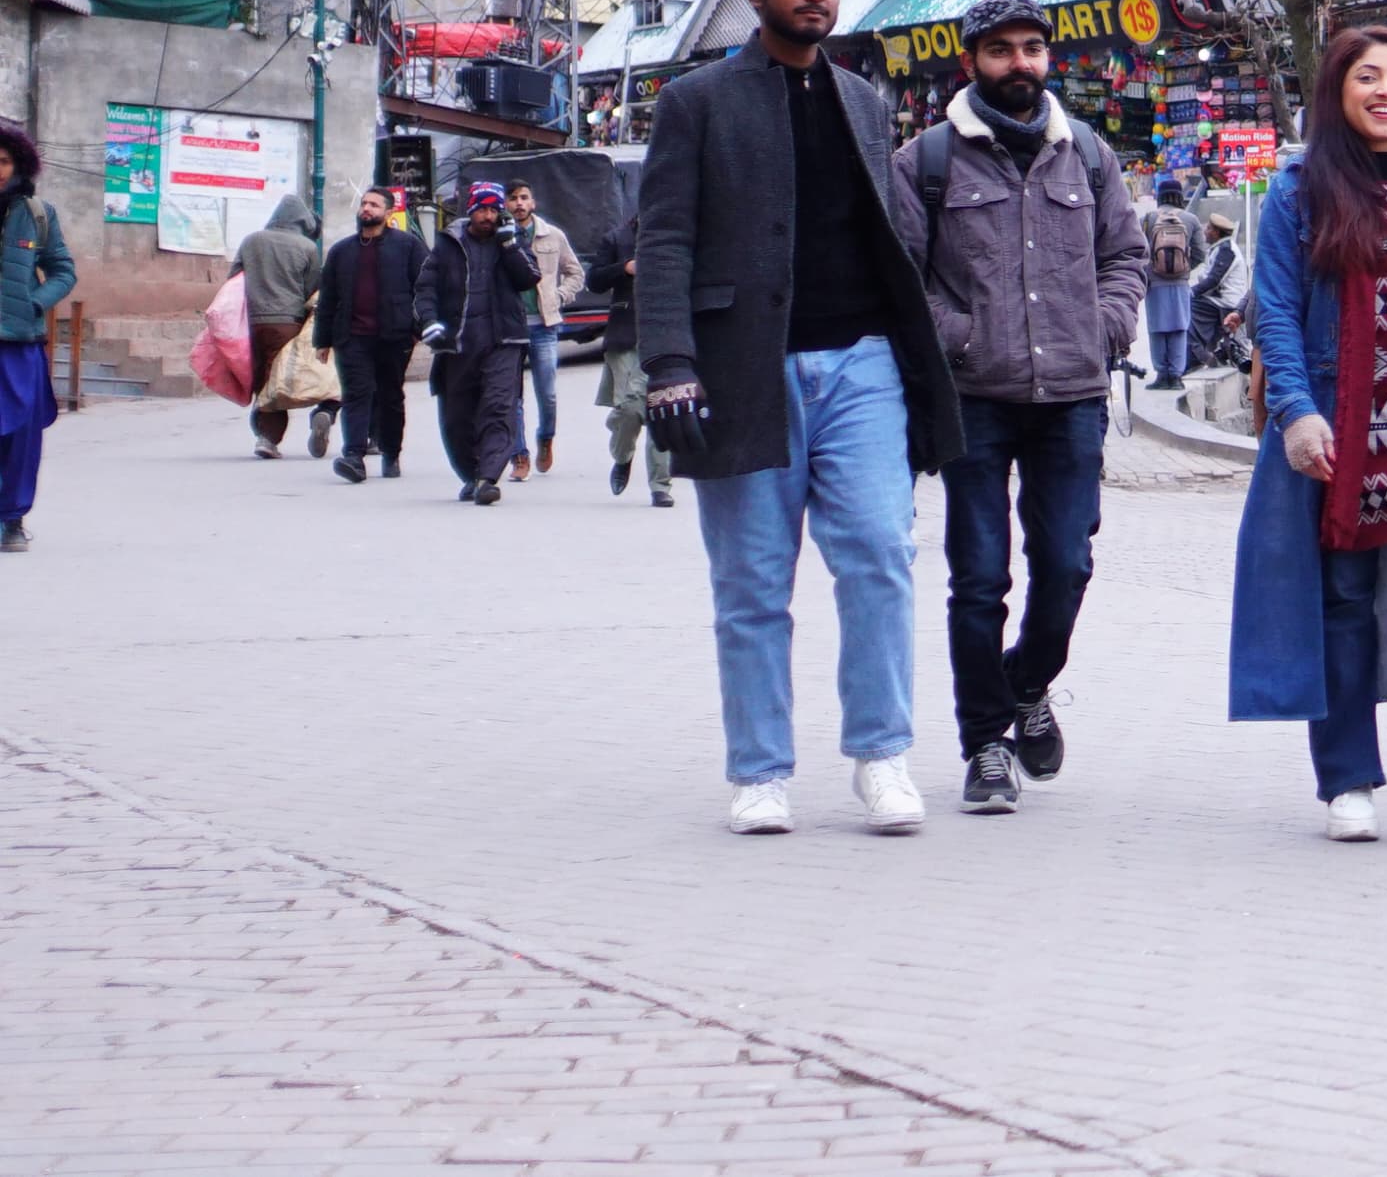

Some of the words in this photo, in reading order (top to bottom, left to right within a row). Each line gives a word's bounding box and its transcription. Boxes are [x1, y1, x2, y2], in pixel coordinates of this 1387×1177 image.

[1221, 133, 1251, 141] Motion
[1253, 132, 1273, 141] Ride
[647, 383, 697, 408] SPORT
